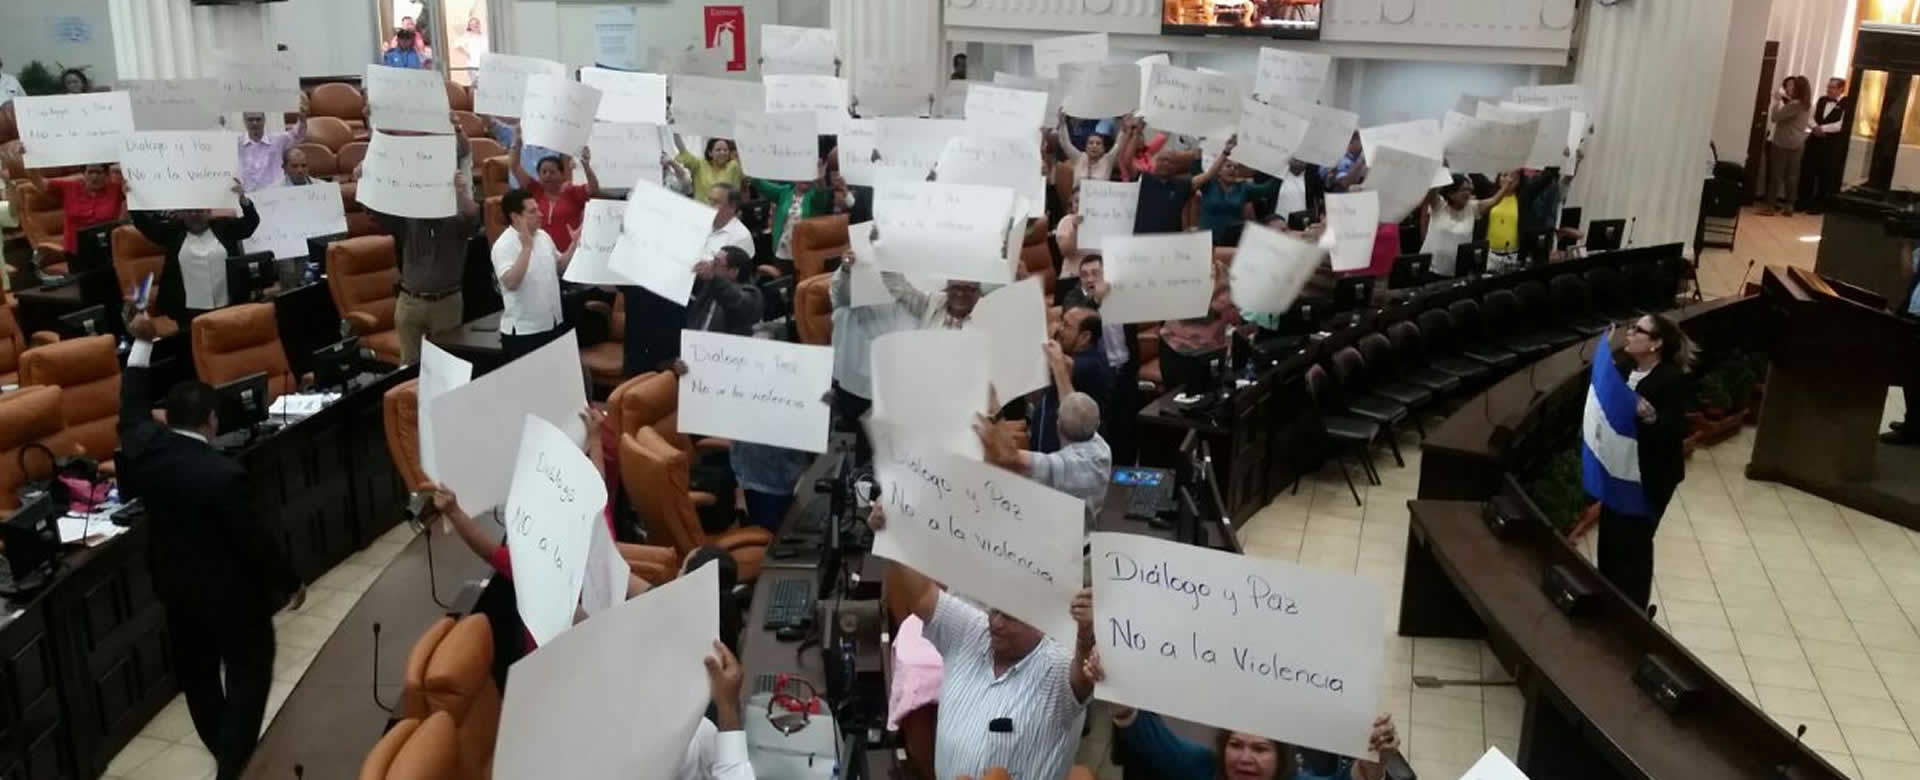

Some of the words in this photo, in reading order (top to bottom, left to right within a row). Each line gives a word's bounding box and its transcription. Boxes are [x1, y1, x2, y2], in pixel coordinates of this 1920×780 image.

[691, 379, 710, 395] No
[891, 480, 915, 517] No
[928, 517, 940, 531] a
[949, 513, 966, 540] la
[973, 532, 1055, 584] violencia
[965, 487, 981, 514] y
[984, 480, 1023, 521] Paz
[1105, 551, 1211, 611] Diálogo
[1222, 588, 1239, 616] y
[1246, 573, 1300, 616] Paz
[1109, 616, 1147, 650] No
[1160, 641, 1178, 659] a
[1192, 631, 1217, 663] la
[1232, 646, 1345, 694] Violencia
